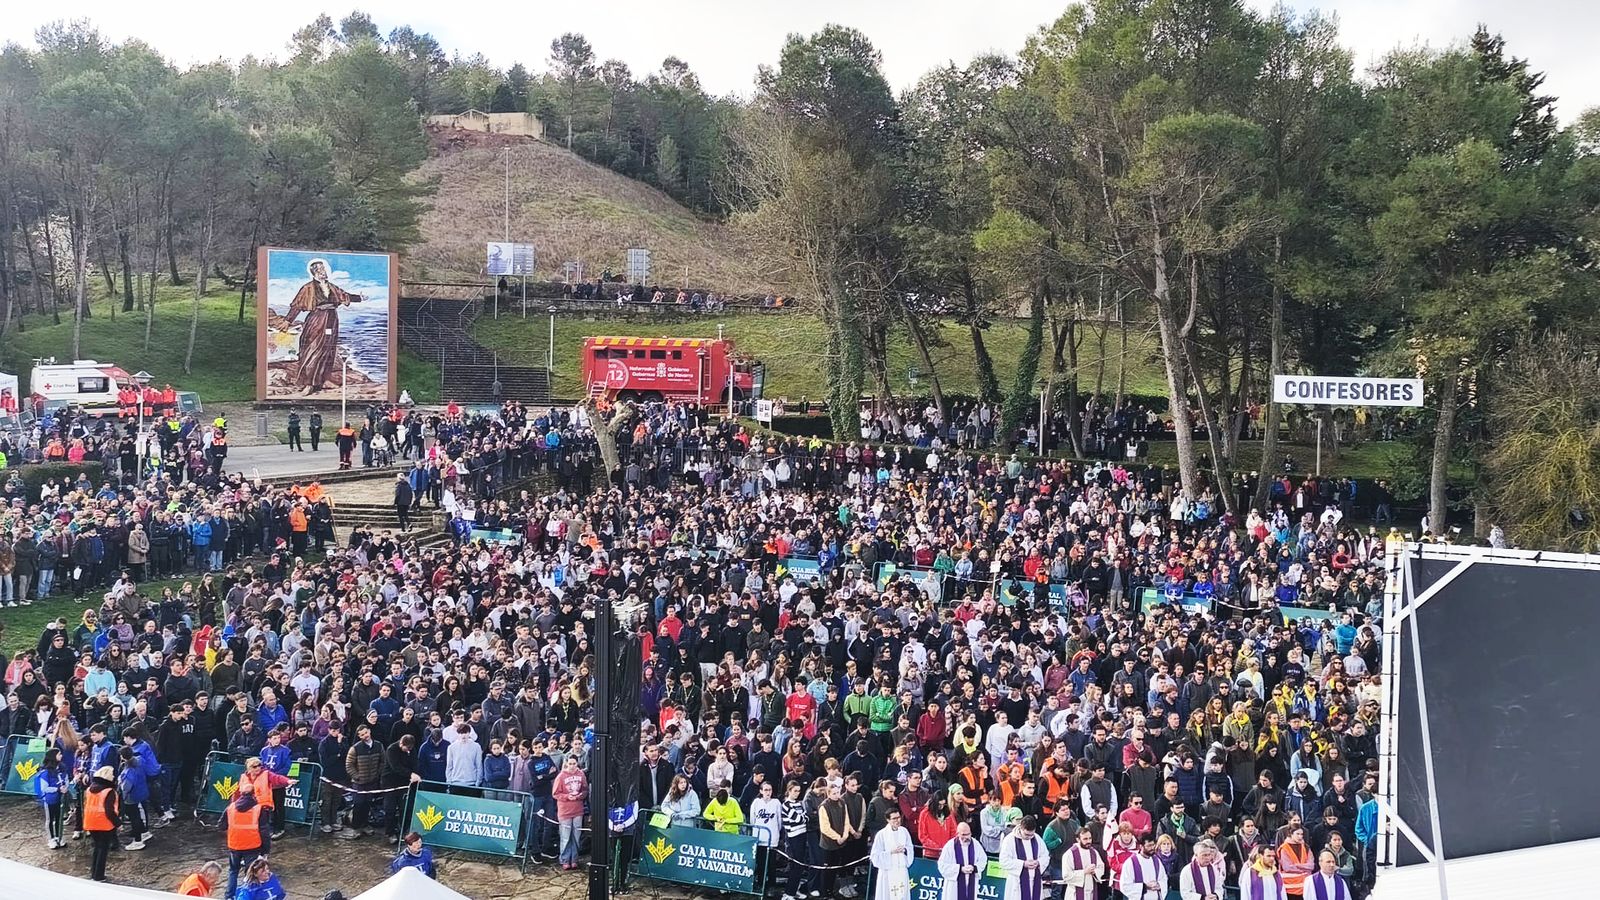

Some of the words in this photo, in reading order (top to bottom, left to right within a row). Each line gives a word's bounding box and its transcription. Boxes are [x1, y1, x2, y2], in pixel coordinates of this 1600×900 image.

[1284, 380, 1413, 401] CONFESORES
[446, 809, 470, 821] CAJA
[474, 812, 512, 827] RURAL
[444, 821, 460, 832] DE
[463, 823, 515, 840] NAVARRA
[680, 844, 707, 857] CAJA
[709, 848, 747, 864] RURAL
[677, 856, 694, 867] DE
[697, 859, 751, 877] NAVARRA
[920, 875, 944, 889] CAJ
[918, 888, 938, 900] DE
